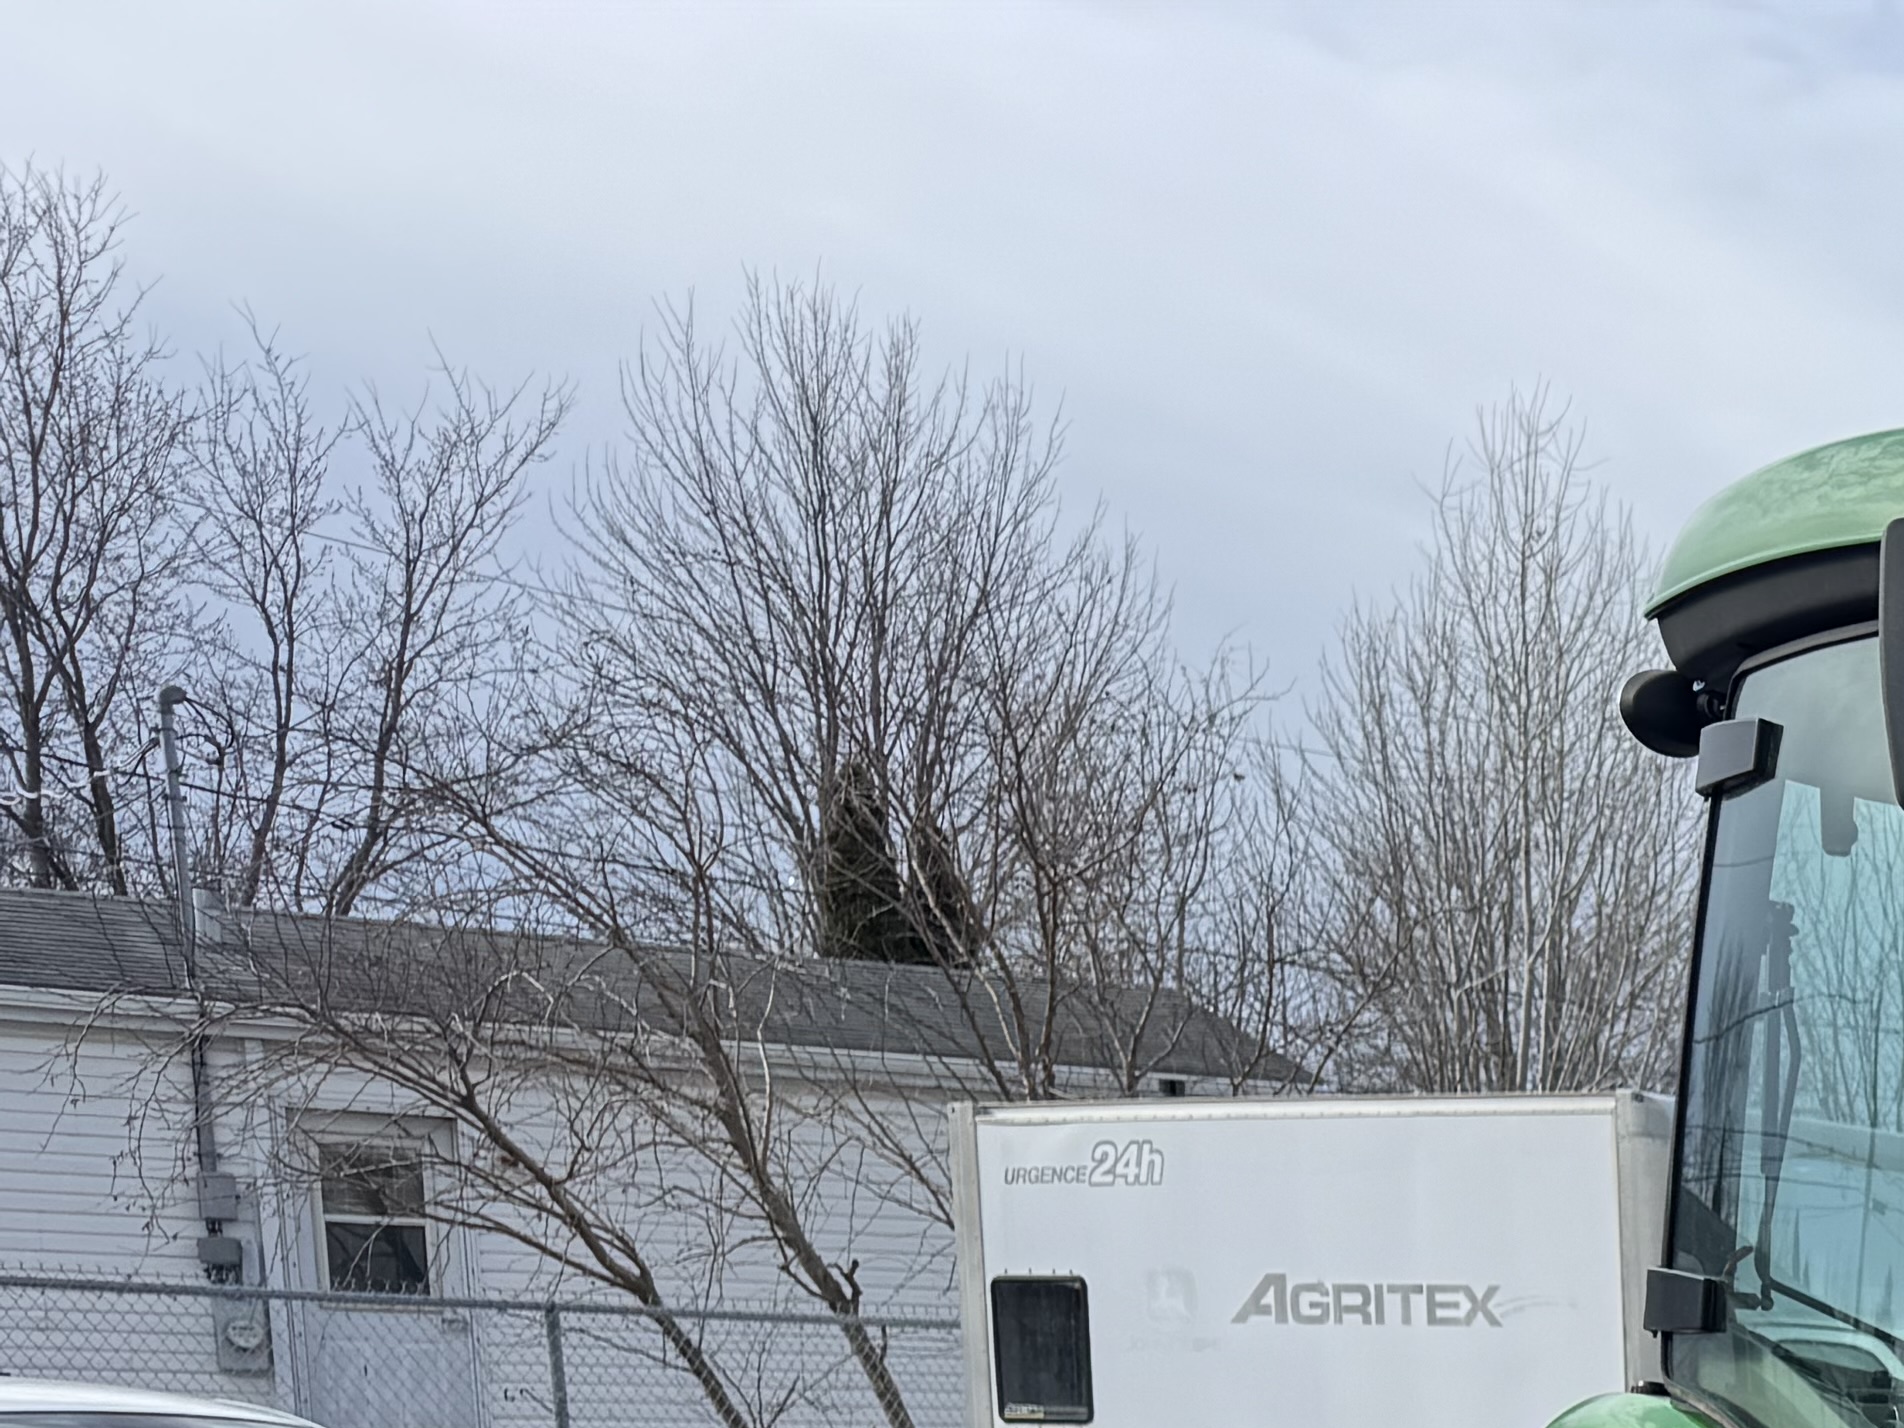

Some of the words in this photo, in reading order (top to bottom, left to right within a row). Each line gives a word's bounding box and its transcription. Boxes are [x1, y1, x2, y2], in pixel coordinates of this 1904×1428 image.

[1003, 1165, 1088, 1185] URGENCE
[1088, 1139, 1165, 1187] 24h
[1230, 1272, 1503, 1328] AGRITEX
